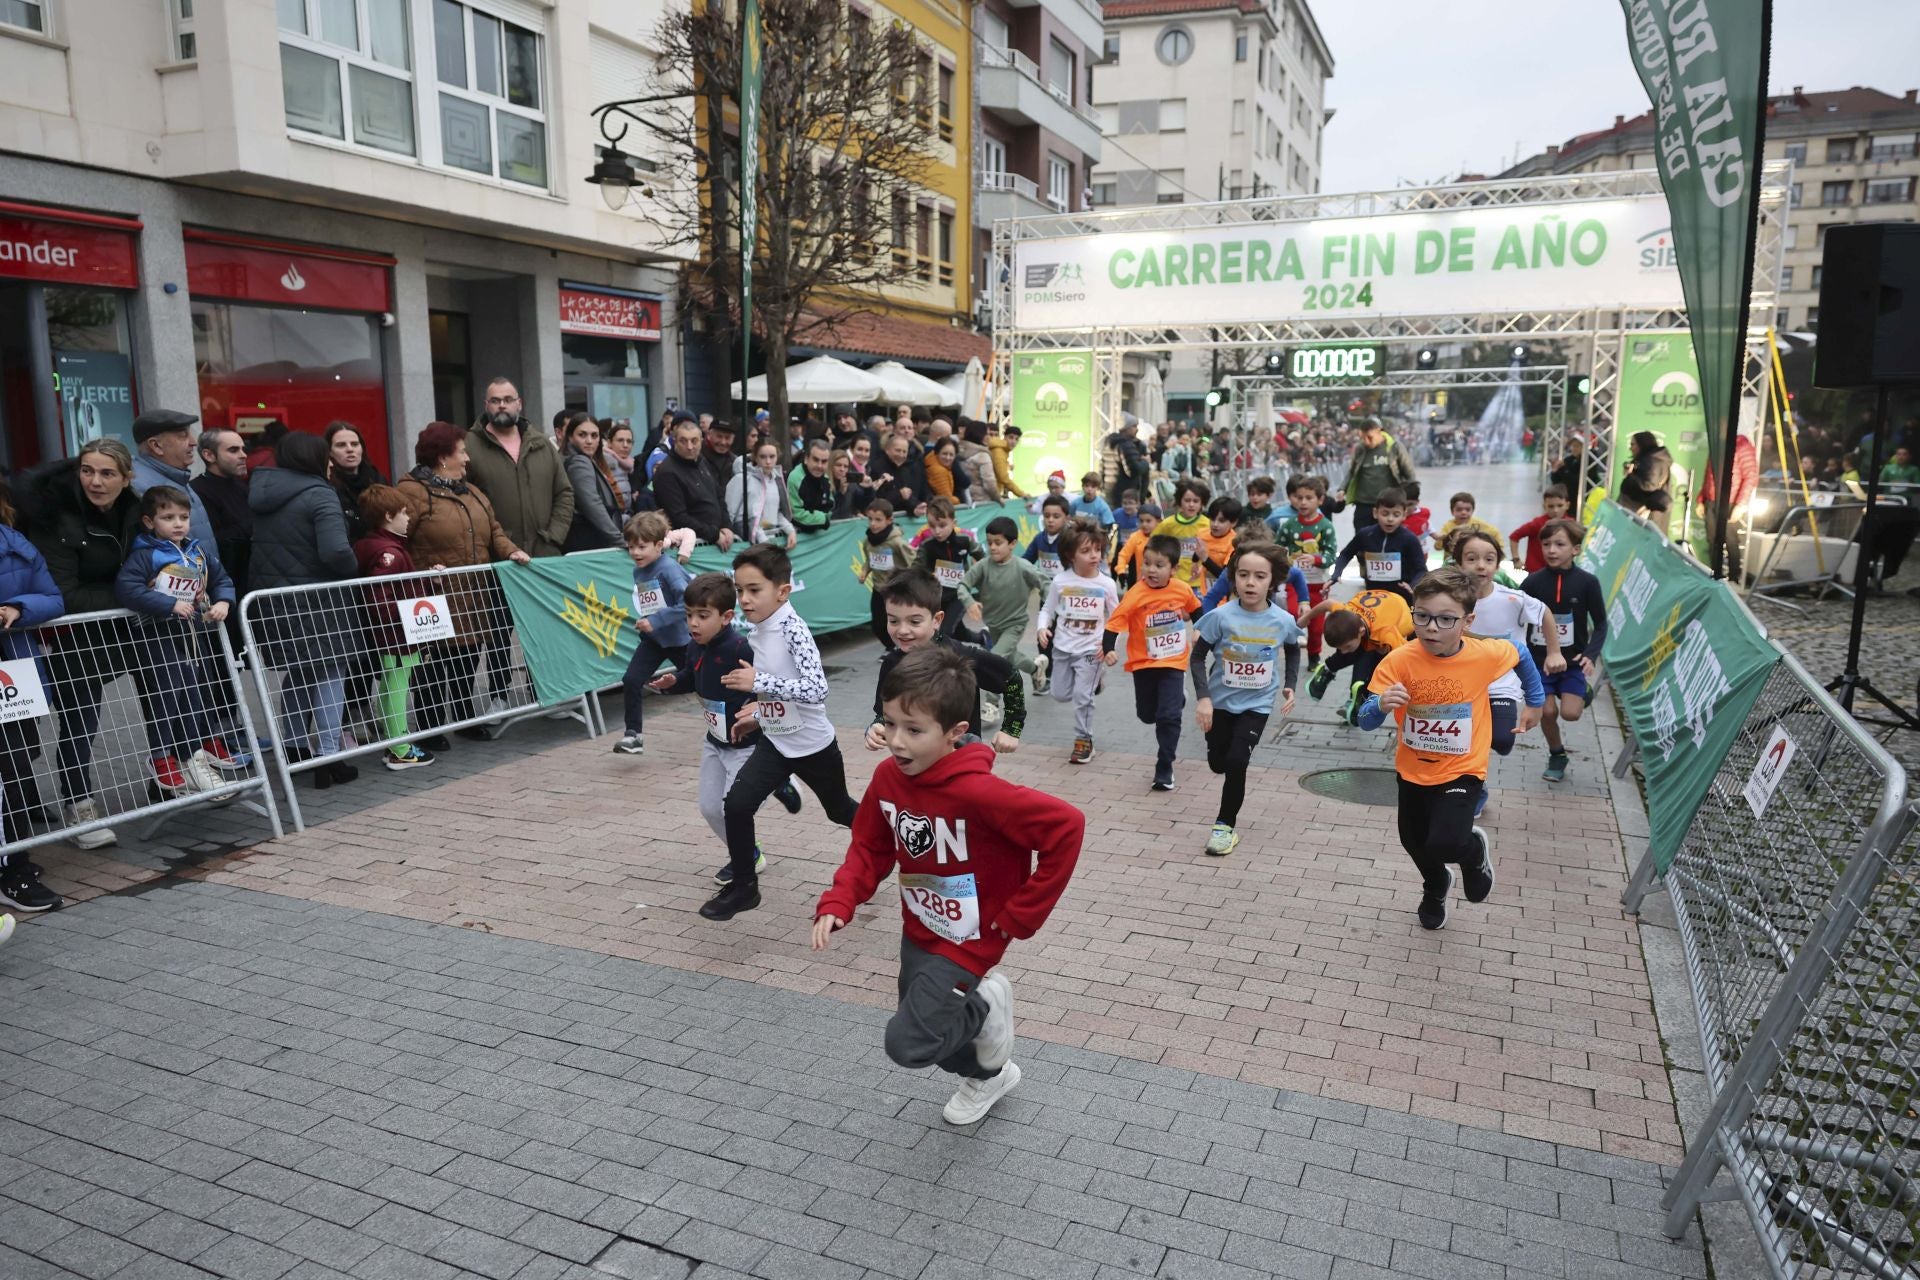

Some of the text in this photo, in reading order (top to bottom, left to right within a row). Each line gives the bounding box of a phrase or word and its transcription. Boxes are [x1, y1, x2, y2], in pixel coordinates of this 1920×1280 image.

[1108, 215, 1608, 289] CARRERA FIN DE AÑO
[1024, 291, 1086, 304] PDMSiero
[1303, 282, 1373, 310] 2024
[561, 296, 642, 312] LA CASA DE LAS
[568, 309, 636, 326] MASCOTAS
[61, 376, 84, 385] MUY
[63, 385, 130, 403] FUERTE
[940, 568, 963, 579] 1306
[1370, 561, 1393, 571] 1310
[168, 575, 201, 592] 1170
[1069, 597, 1098, 609] 1264
[1536, 624, 1568, 636] 13
[1153, 632, 1181, 648] 1262
[1228, 661, 1266, 676] 1284
[4, 699, 34, 708] eventos
[1408, 717, 1461, 737] 1244
[1419, 735, 1449, 744] CARLOS
[1423, 743, 1464, 752] PDMSiero
[905, 887, 962, 922] 1288
[924, 910, 950, 928] NACHO
